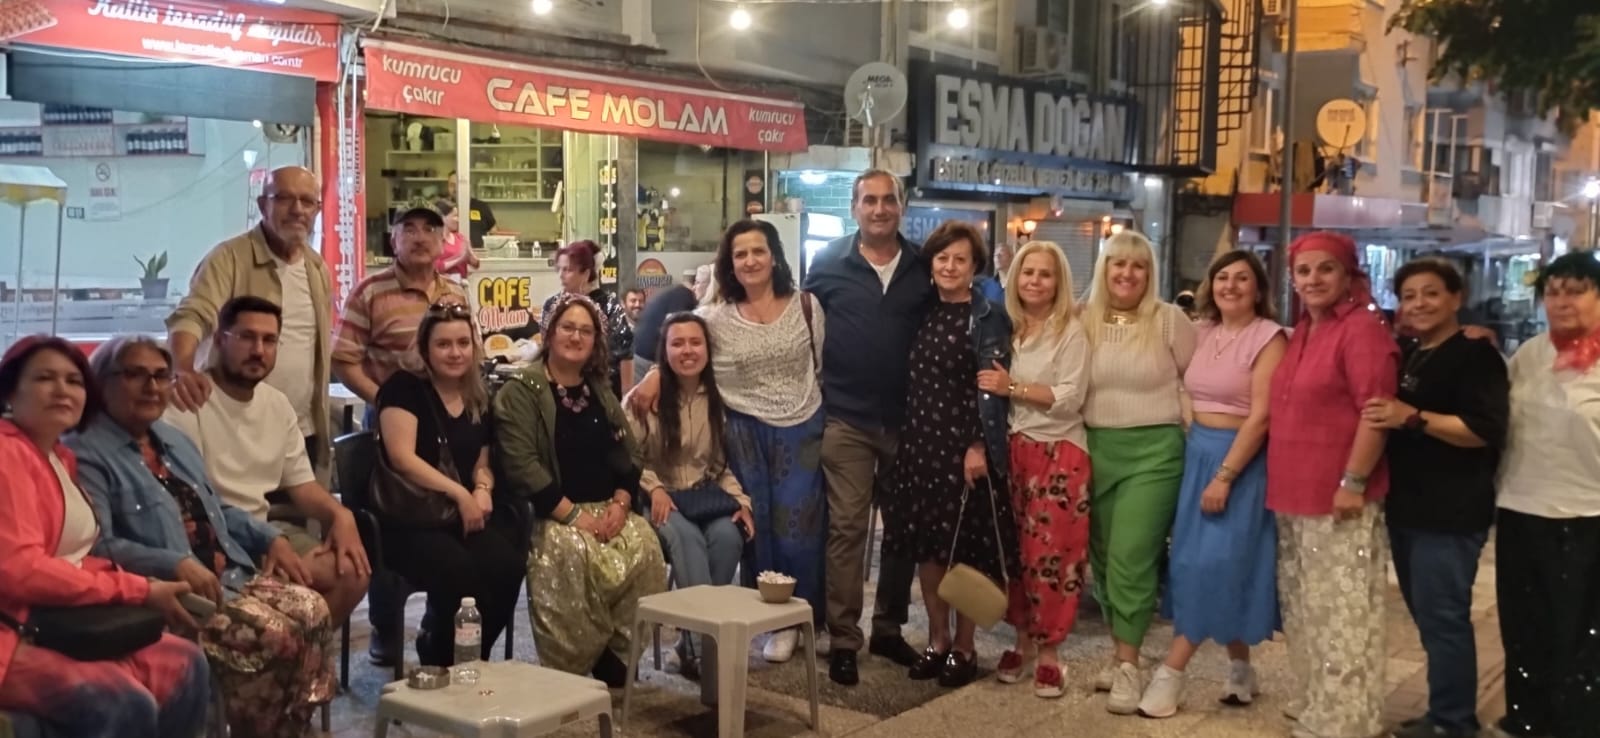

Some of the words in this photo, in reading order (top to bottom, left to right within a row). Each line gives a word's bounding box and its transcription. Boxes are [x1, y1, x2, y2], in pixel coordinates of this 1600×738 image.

[382, 54, 461, 84] kumrucu
[402, 84, 445, 106] çakır
[486, 77, 592, 121] CAFE
[601, 93, 729, 136] MOLAM
[748, 106, 796, 125] kumrucu
[935, 74, 1029, 152] ESMA
[1034, 92, 1126, 161] DOĞAN
[757, 126, 785, 145] çakır
[478, 276, 531, 309] CAFE
